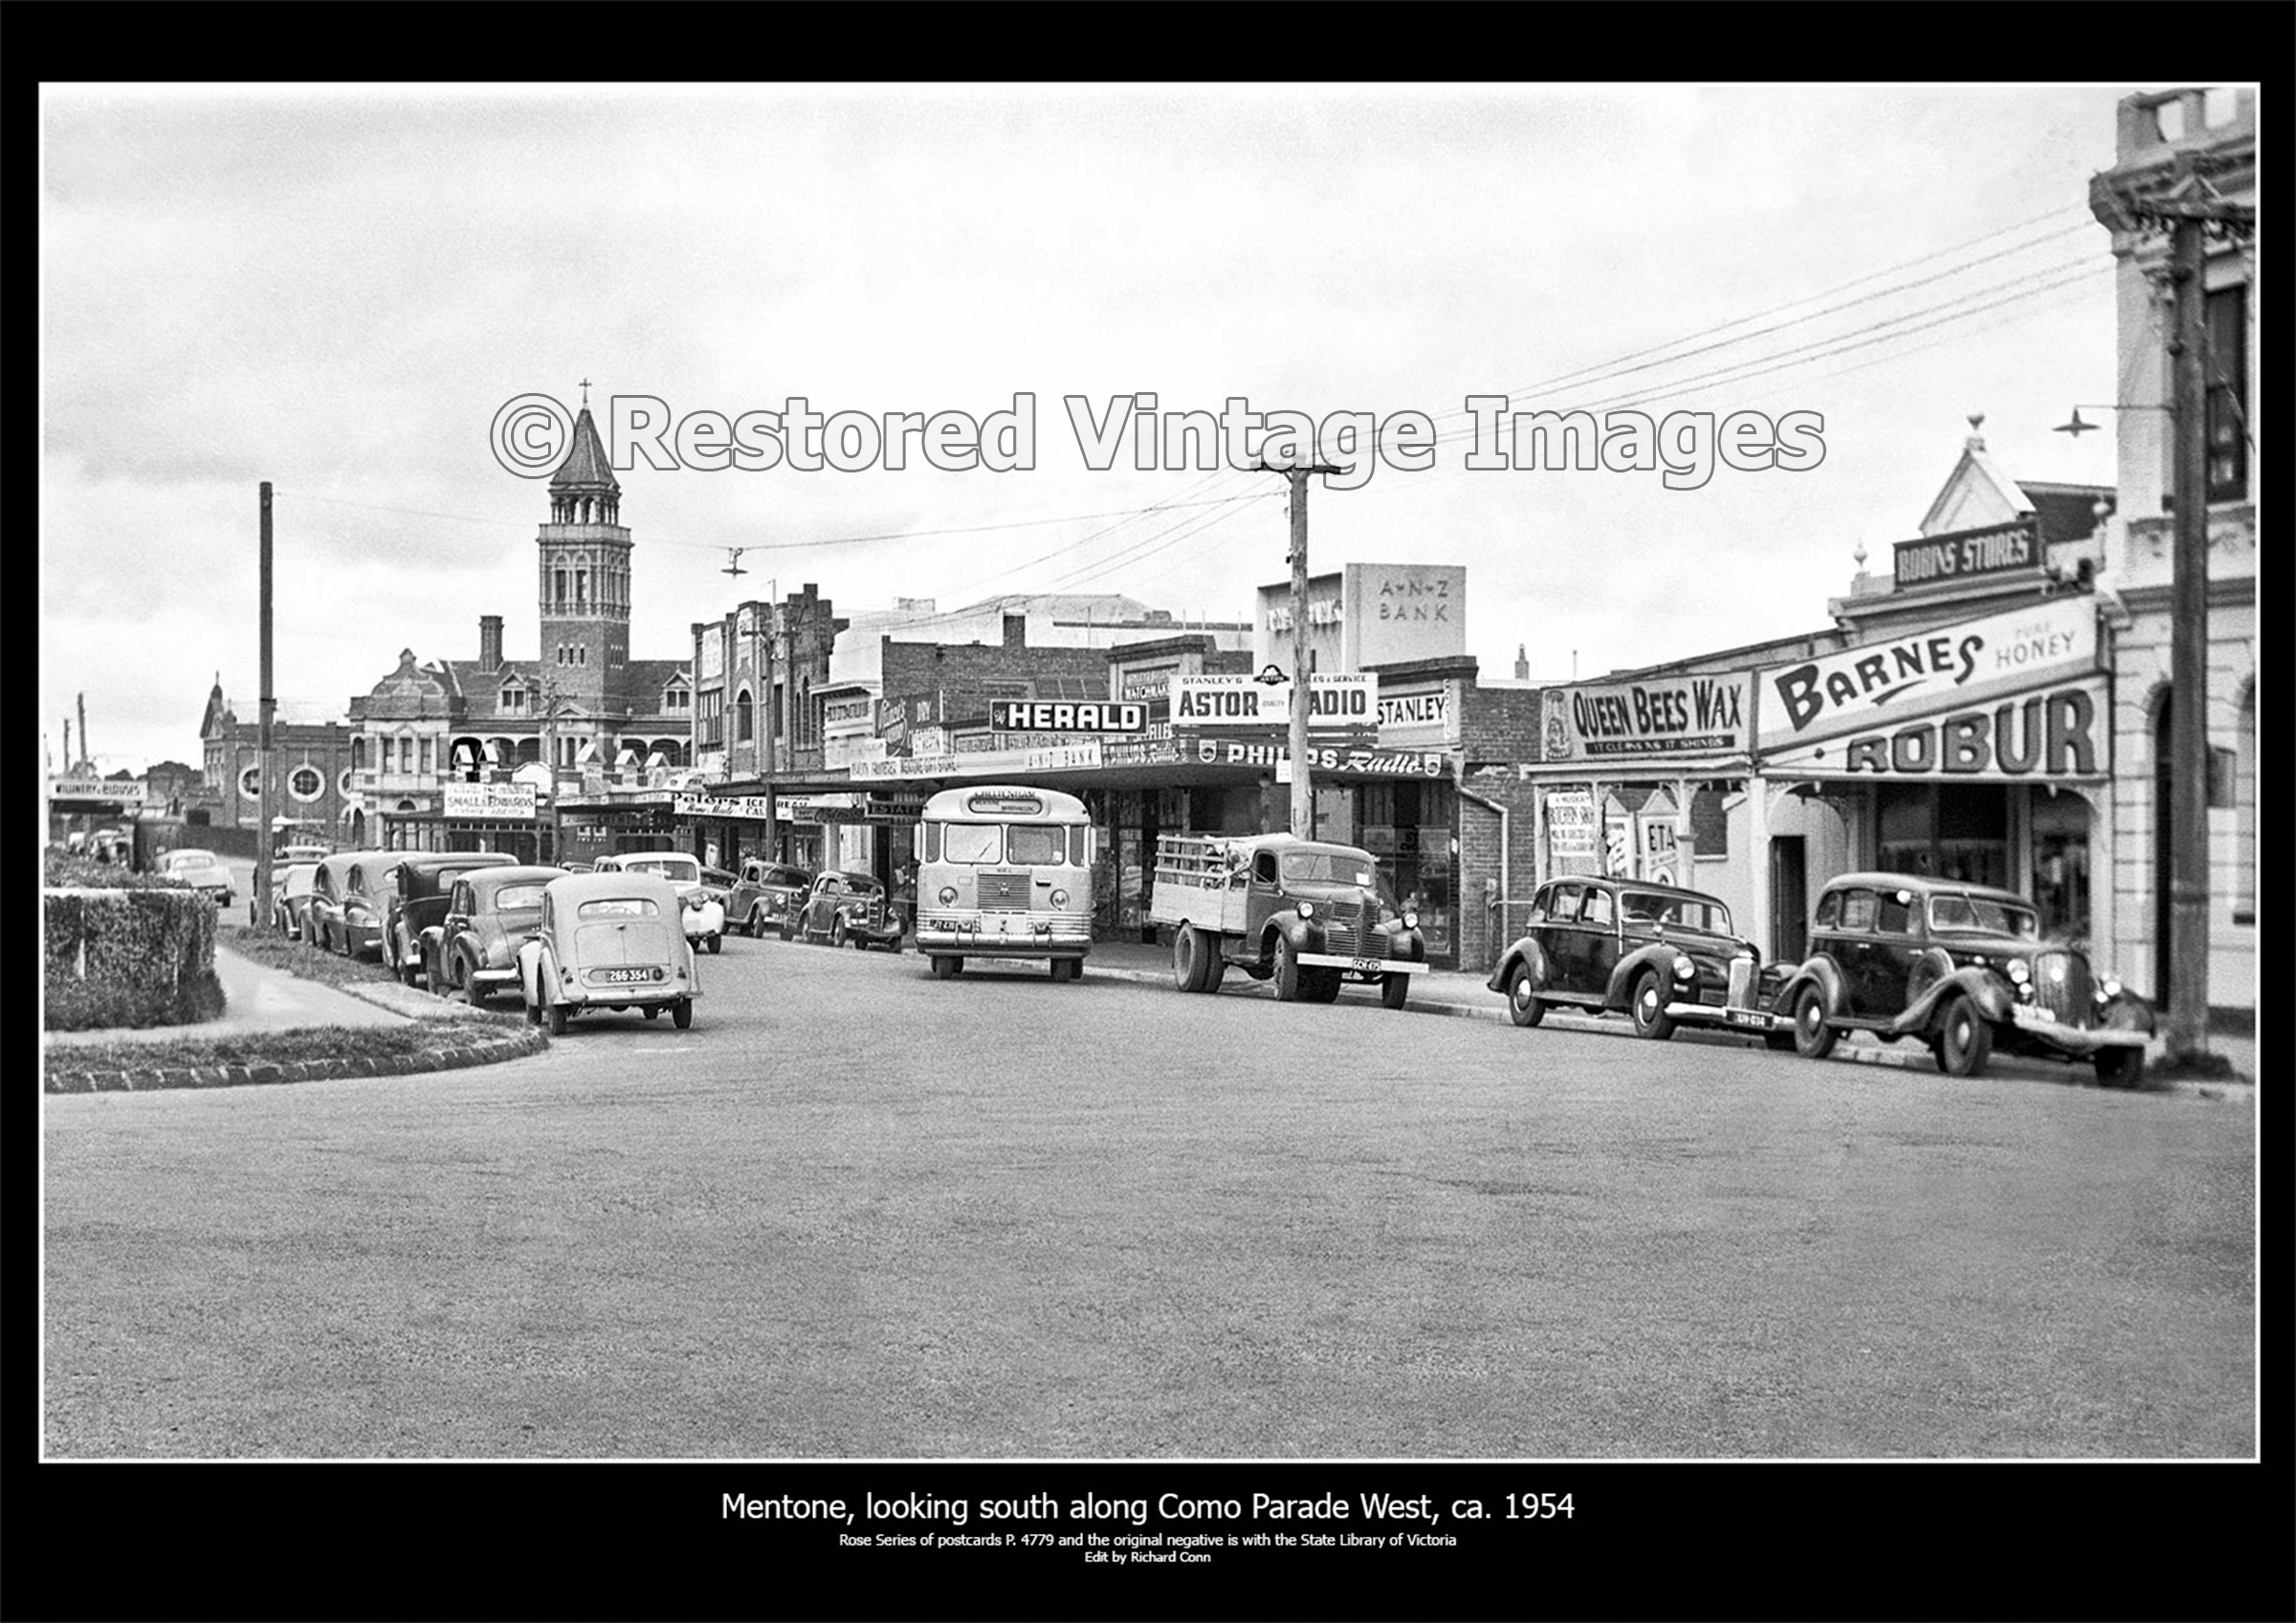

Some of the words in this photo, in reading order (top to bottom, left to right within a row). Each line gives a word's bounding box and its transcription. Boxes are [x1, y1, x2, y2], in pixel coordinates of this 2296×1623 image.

[1898, 541, 1956, 582] ROBINS
[1963, 529, 2029, 572] STORES
[1380, 603, 1449, 623] BANK
[1996, 630, 2076, 669] HONEY
[1181, 676, 1244, 685] STANLEY'S
[1334, 673, 1367, 683] SERVICE
[1774, 635, 1984, 731] BARNES
[1008, 703, 1141, 731] HERALD
[1179, 690, 1260, 717] ASTOR
[1378, 696, 1446, 726] STANLEY
[1574, 691, 1633, 738] QUEEN
[1631, 686, 1689, 735] BEES
[1692, 678, 1743, 731] WAX
[1845, 688, 2097, 775] ROBUR
[1338, 750, 1424, 774] Radio
[746, 798, 764, 807] ICE
[1647, 823, 1677, 851] ETA
